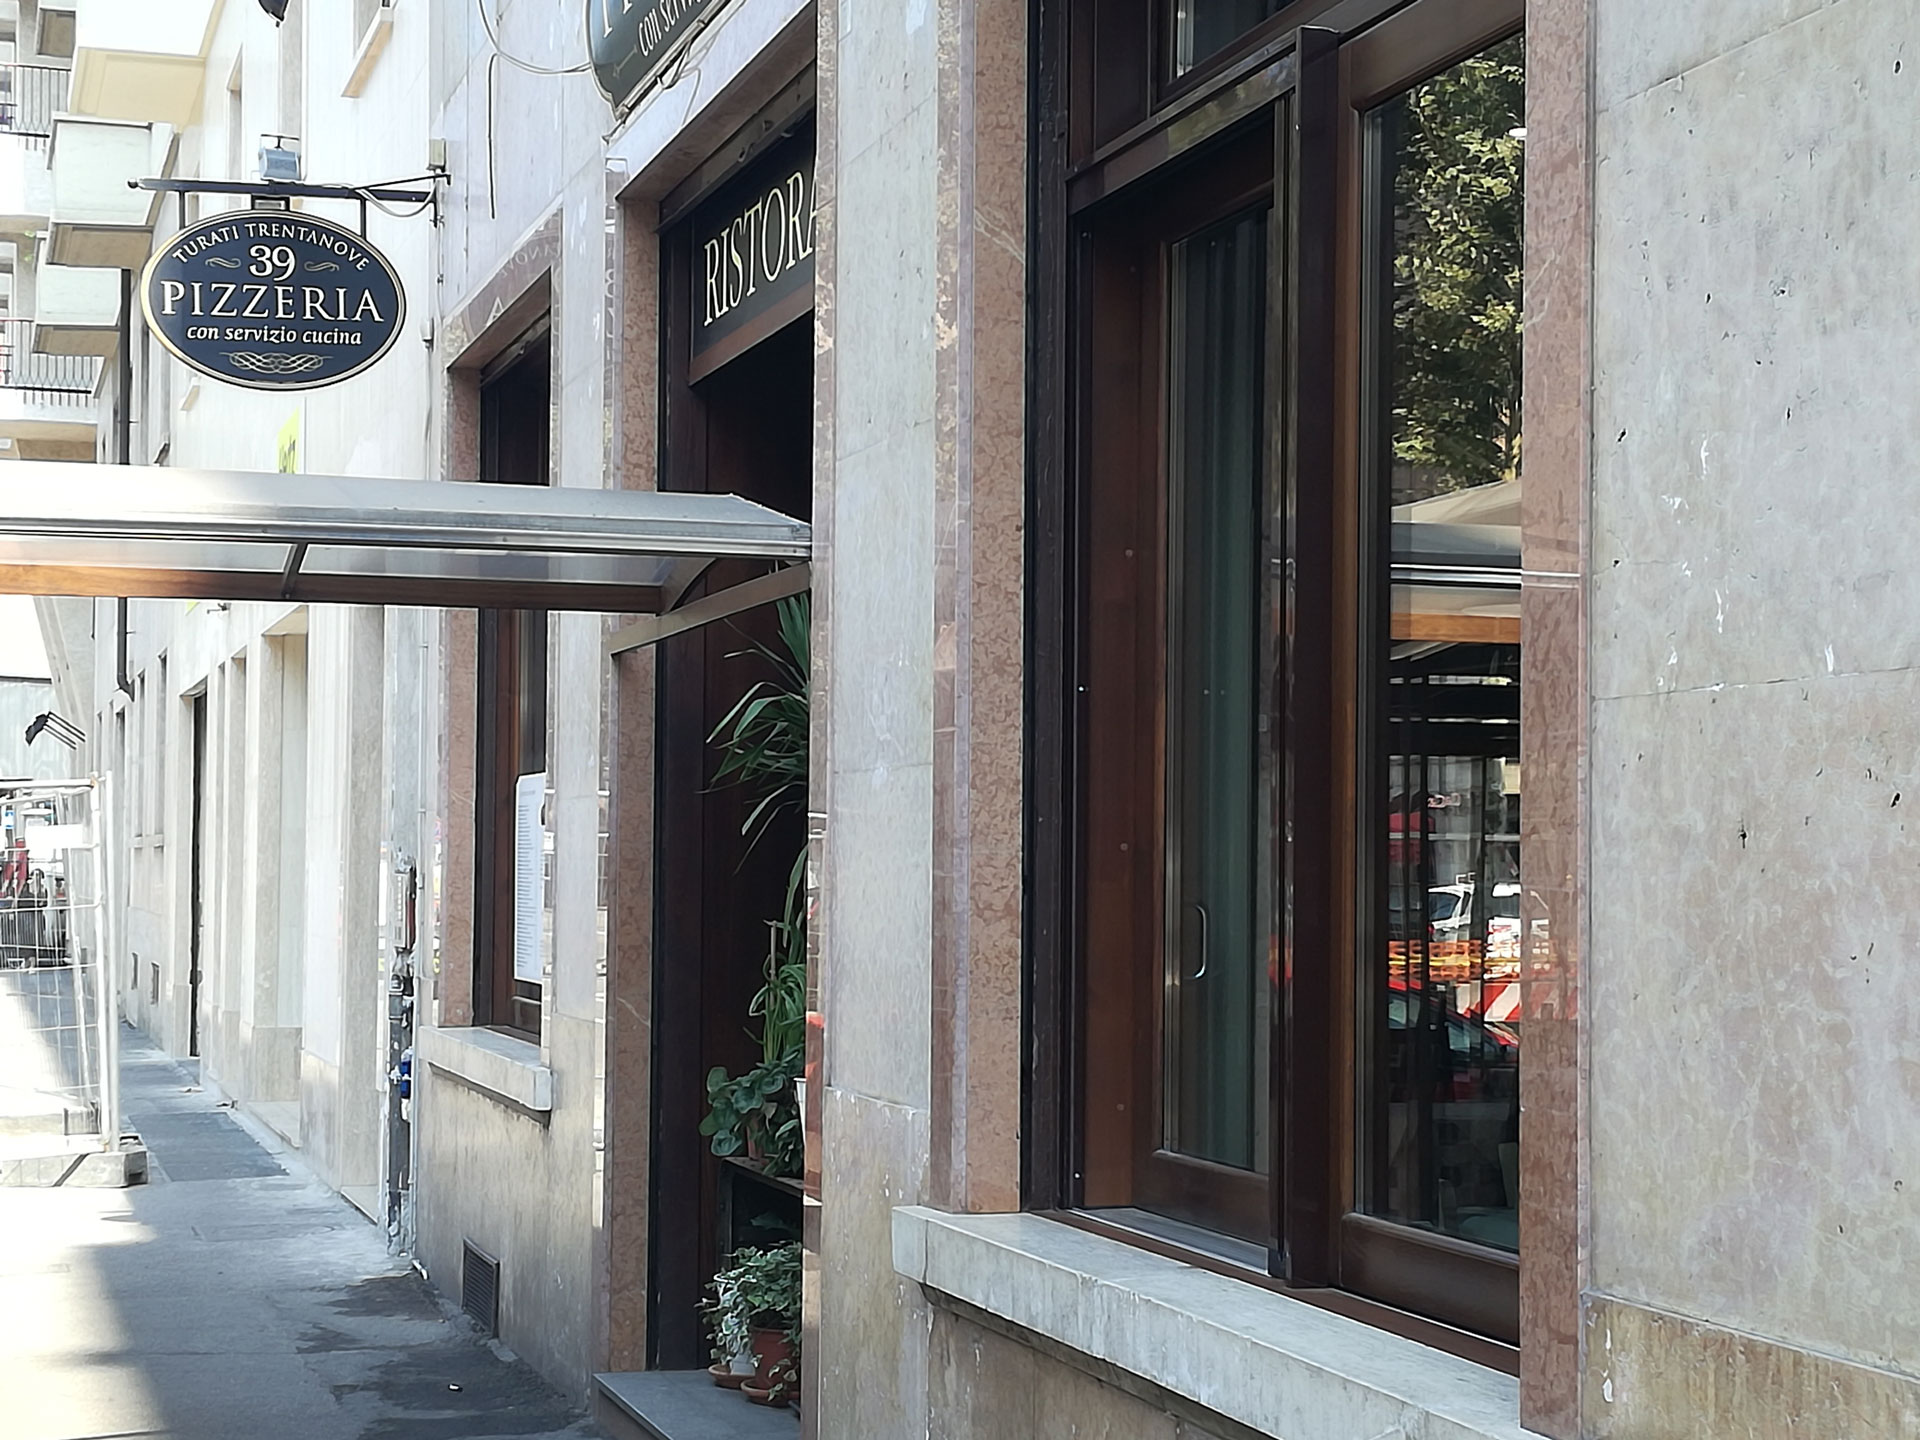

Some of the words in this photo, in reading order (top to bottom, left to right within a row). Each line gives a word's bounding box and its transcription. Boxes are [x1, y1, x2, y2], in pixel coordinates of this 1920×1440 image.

[638, 8, 662, 57] con
[172, 225, 240, 263] TURATI
[244, 223, 370, 271] TRENTANOVE
[249, 244, 297, 281] 39
[160, 281, 385, 322] PIZZERIA
[187, 326, 219, 340] con
[224, 325, 297, 344] servizio
[302, 328, 363, 345] cucina
